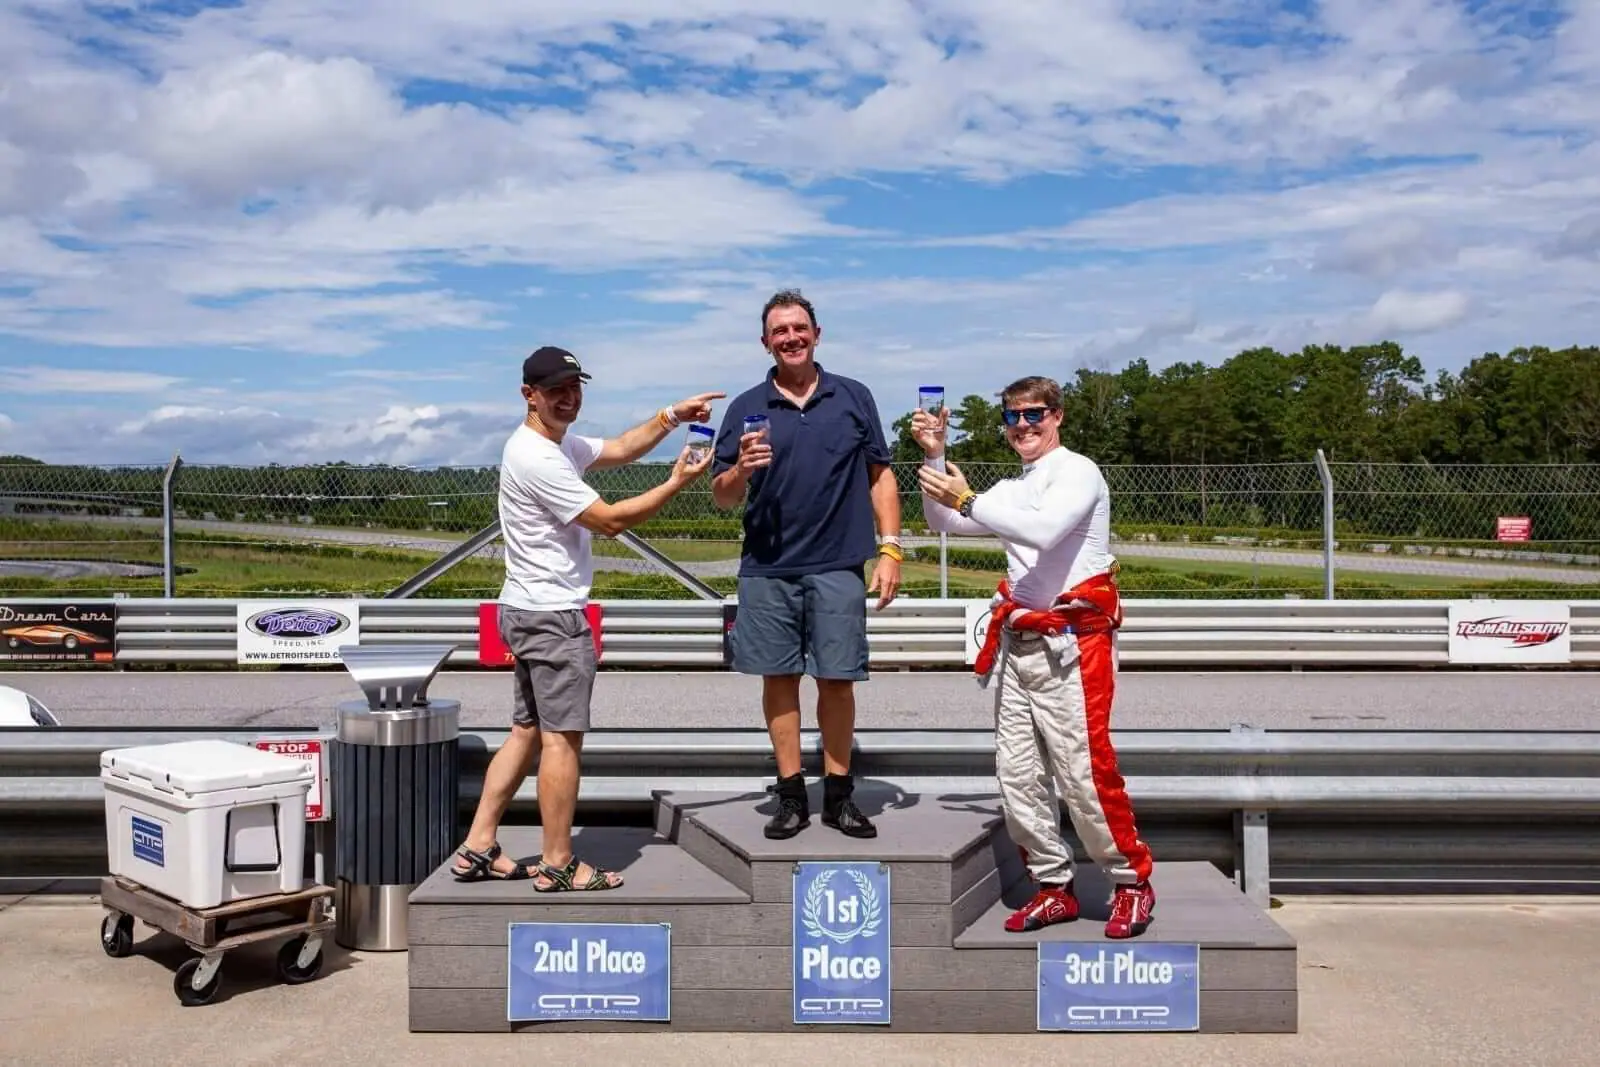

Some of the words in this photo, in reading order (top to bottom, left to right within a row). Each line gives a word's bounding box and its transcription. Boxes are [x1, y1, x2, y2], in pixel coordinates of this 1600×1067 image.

[0, 606, 62, 621] Dream
[64, 606, 112, 621] Cars
[259, 614, 337, 637] Detroit
[245, 652, 341, 660] WWW.DETROITSPEED.C
[268, 743, 309, 753] STOP
[824, 890, 859, 923] 1st
[534, 938, 578, 973] 2nd
[586, 939, 646, 973] Place
[802, 945, 881, 980] Place
[1065, 950, 1105, 985] 3rd
[1114, 950, 1173, 985] Place
